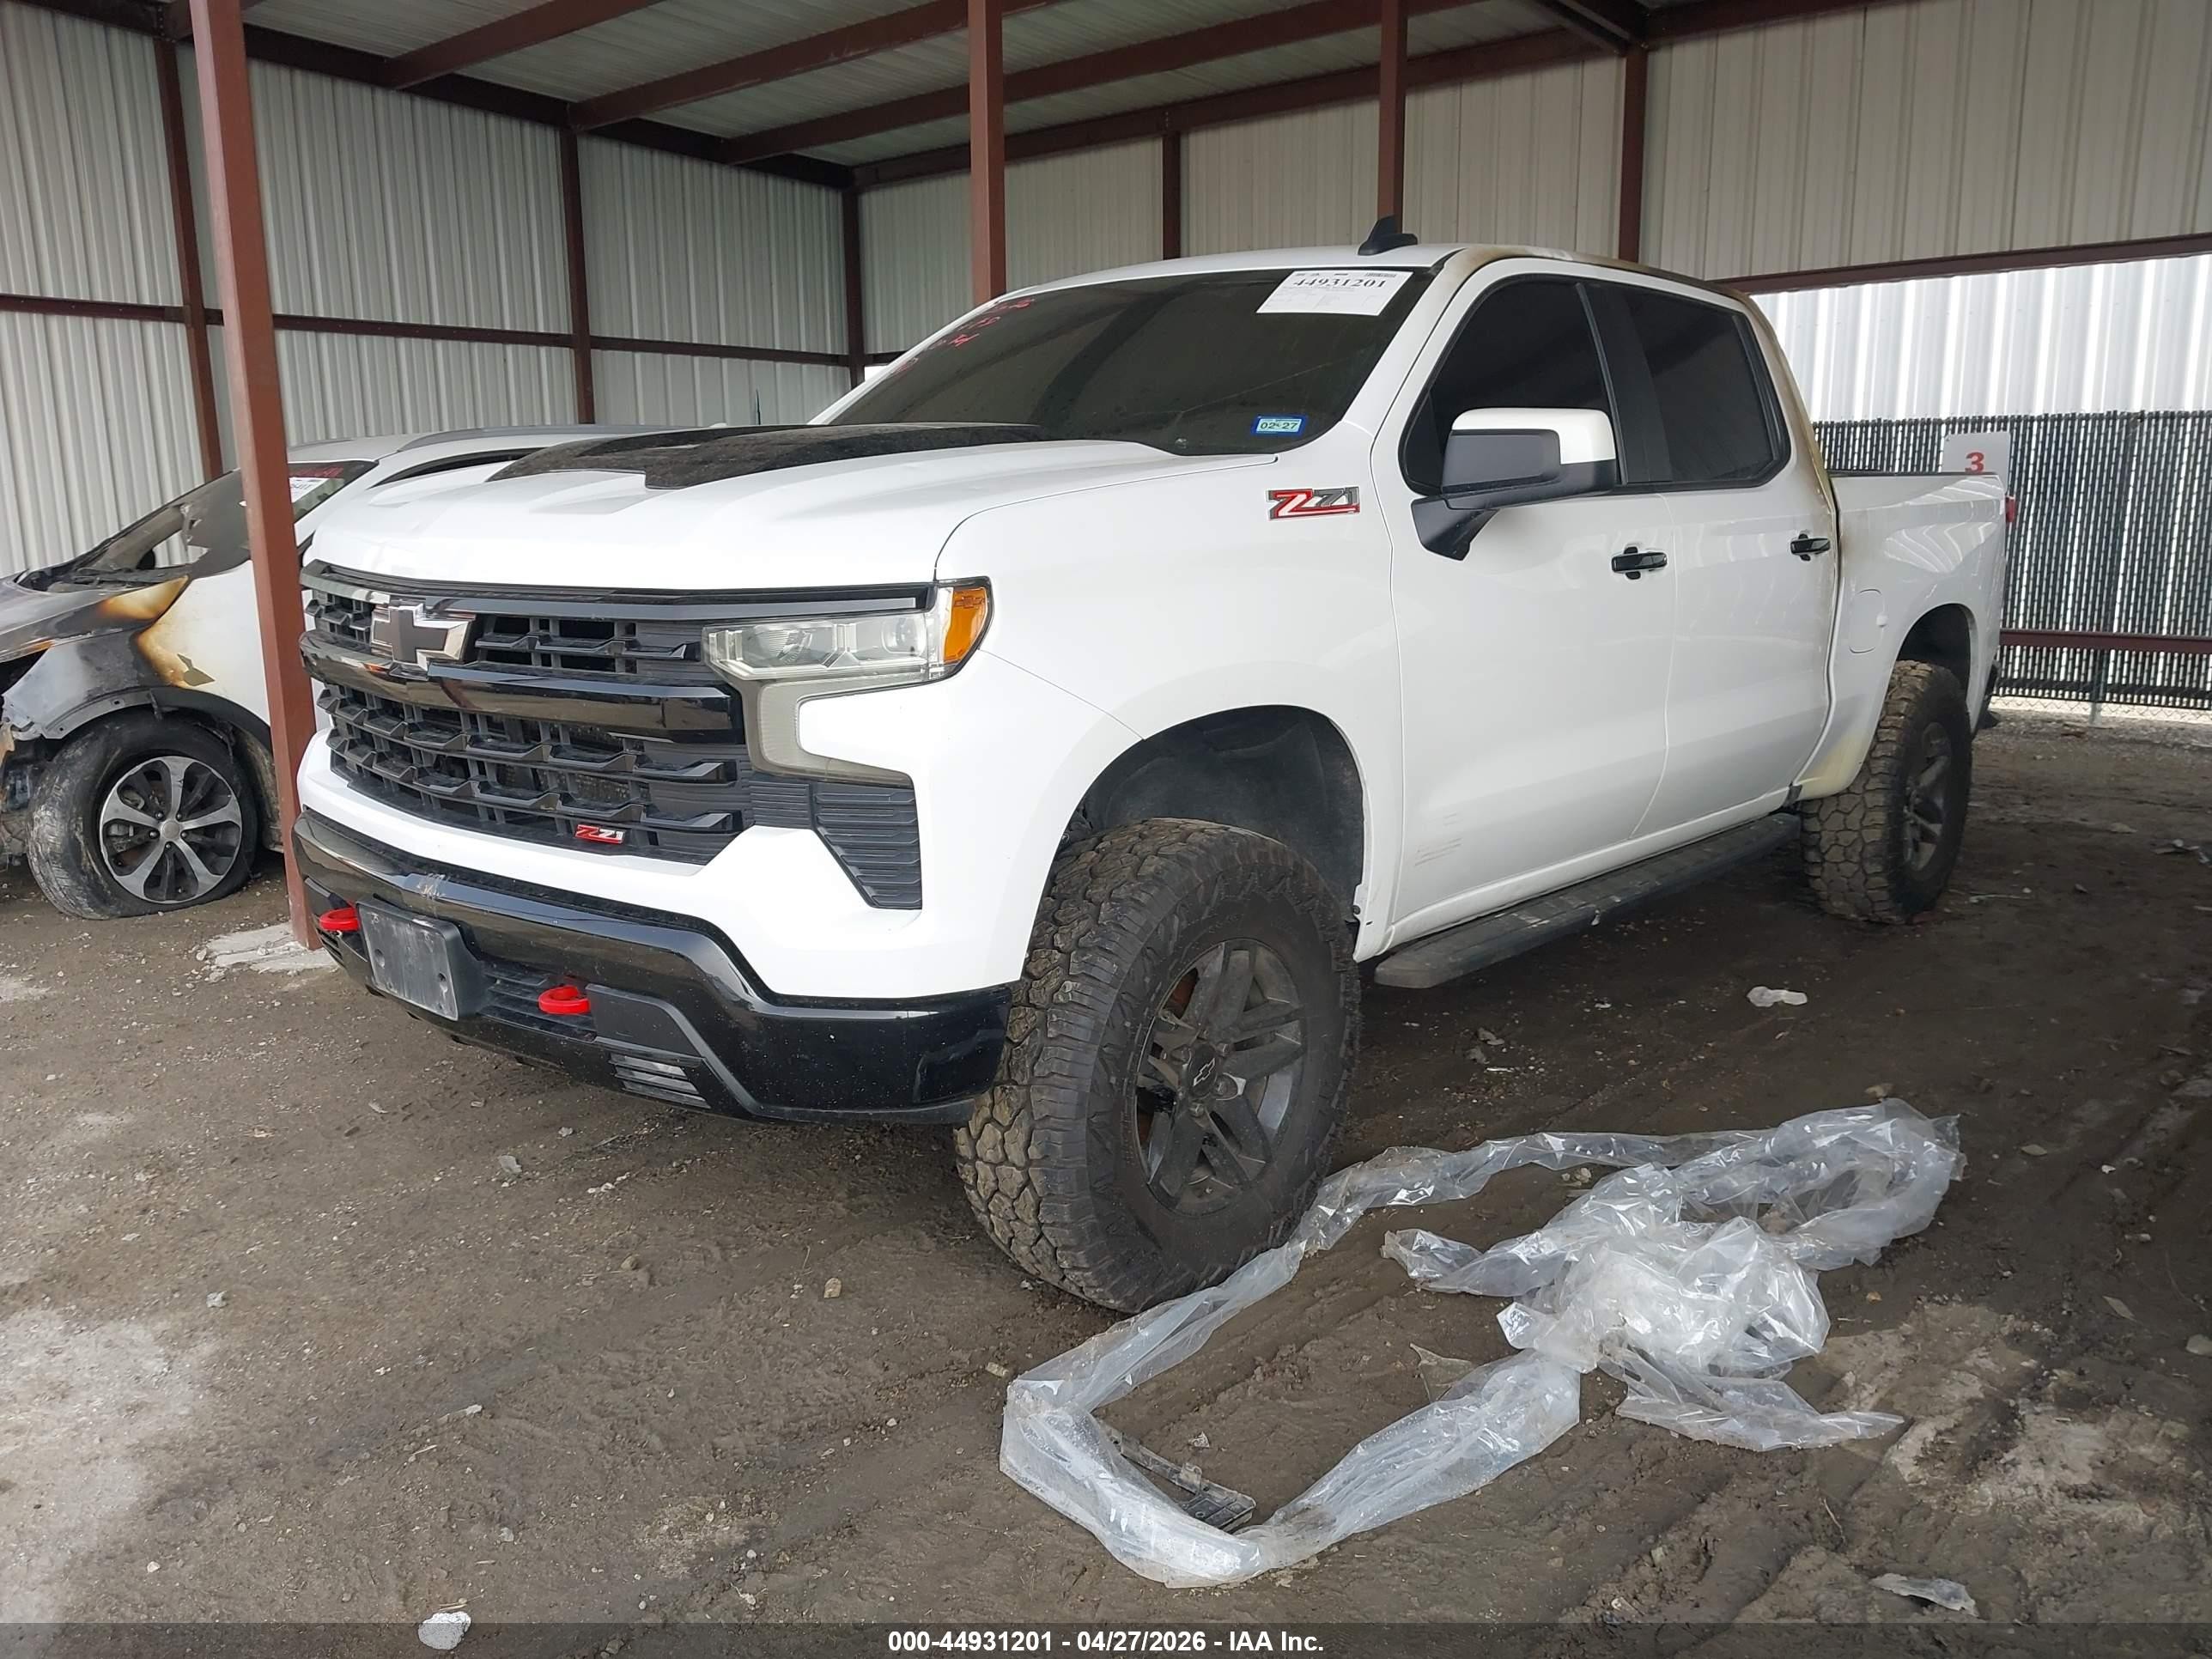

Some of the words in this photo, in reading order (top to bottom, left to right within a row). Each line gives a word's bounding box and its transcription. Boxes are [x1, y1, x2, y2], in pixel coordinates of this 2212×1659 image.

[1293, 278, 1386, 288] 44931201
[1965, 452, 1984, 473] 3
[1267, 487, 1360, 520] Z71
[574, 823, 624, 844] Z71
